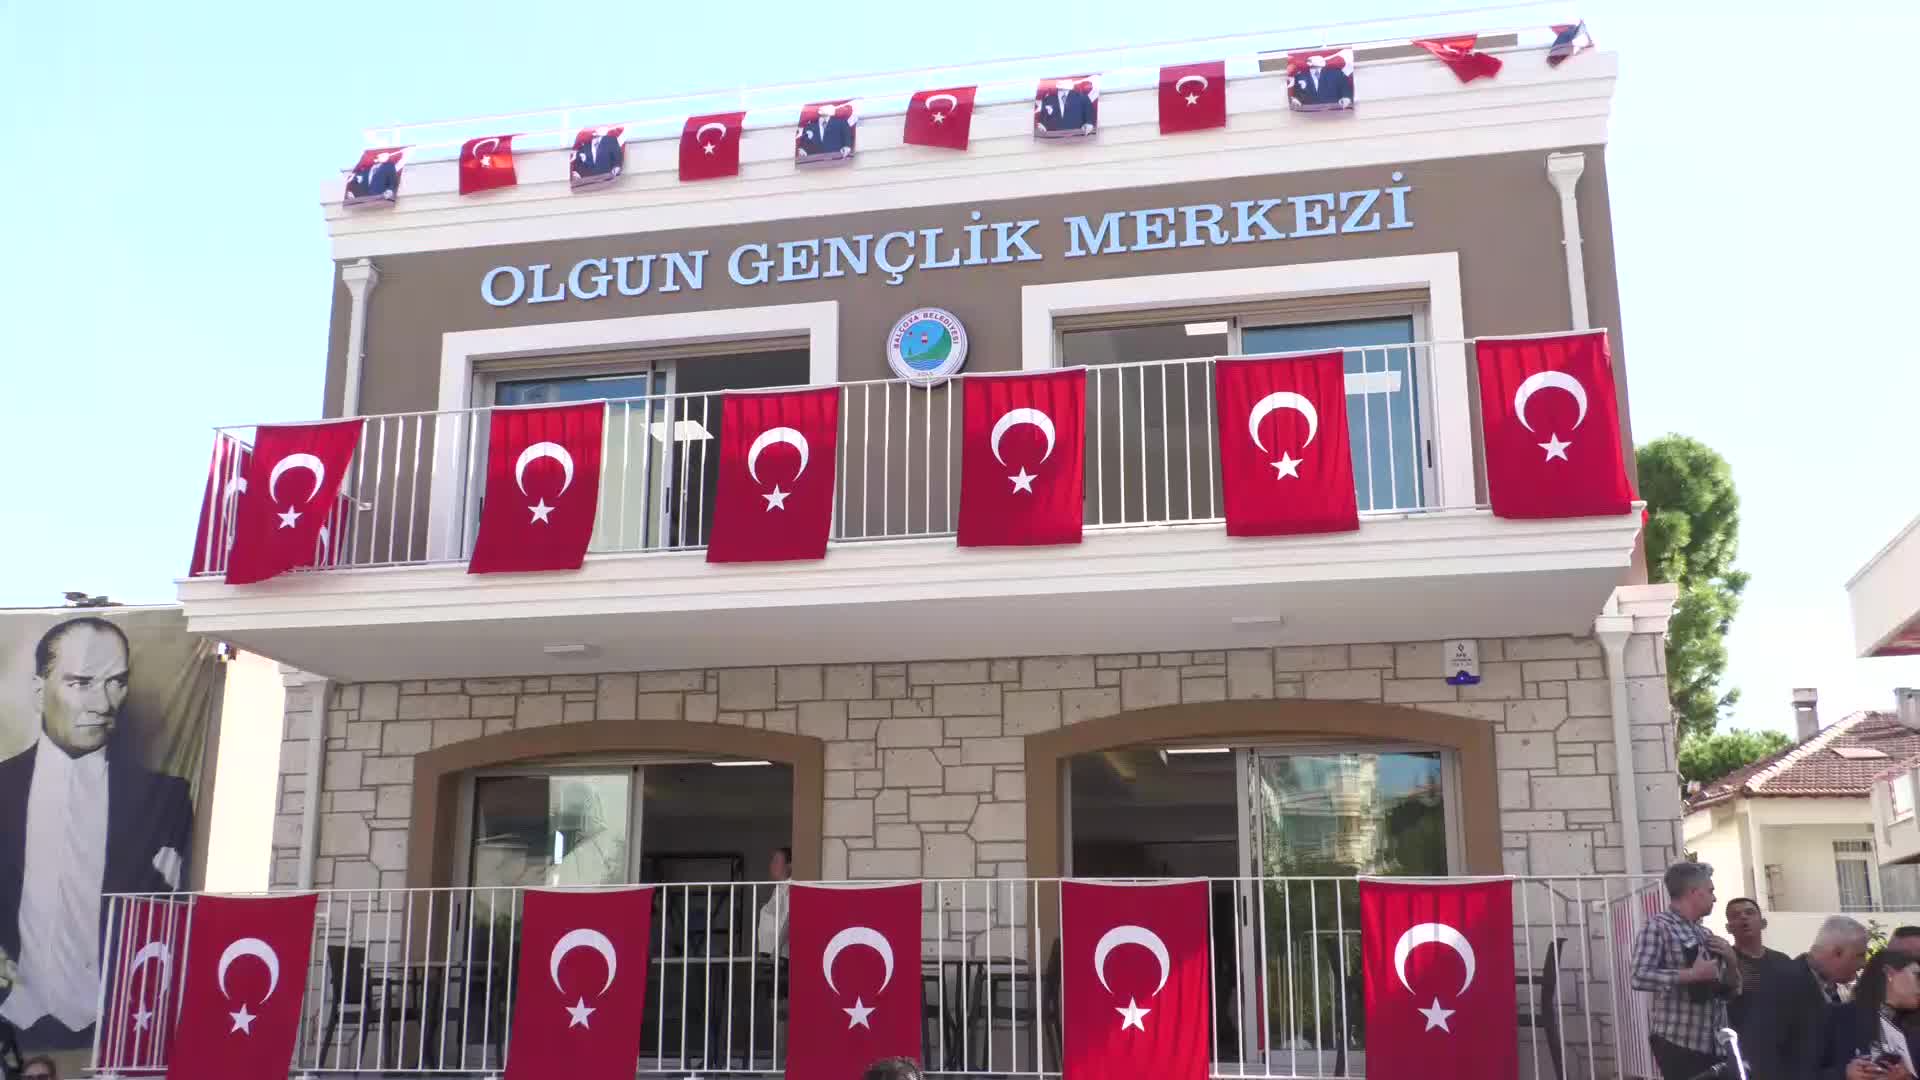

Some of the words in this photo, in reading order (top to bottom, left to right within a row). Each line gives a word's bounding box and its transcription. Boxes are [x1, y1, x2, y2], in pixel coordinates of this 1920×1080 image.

[481, 250, 709, 306] OLGUN
[727, 211, 1043, 285] GENÇLİK
[1063, 172, 1415, 257] MERKEZİ
